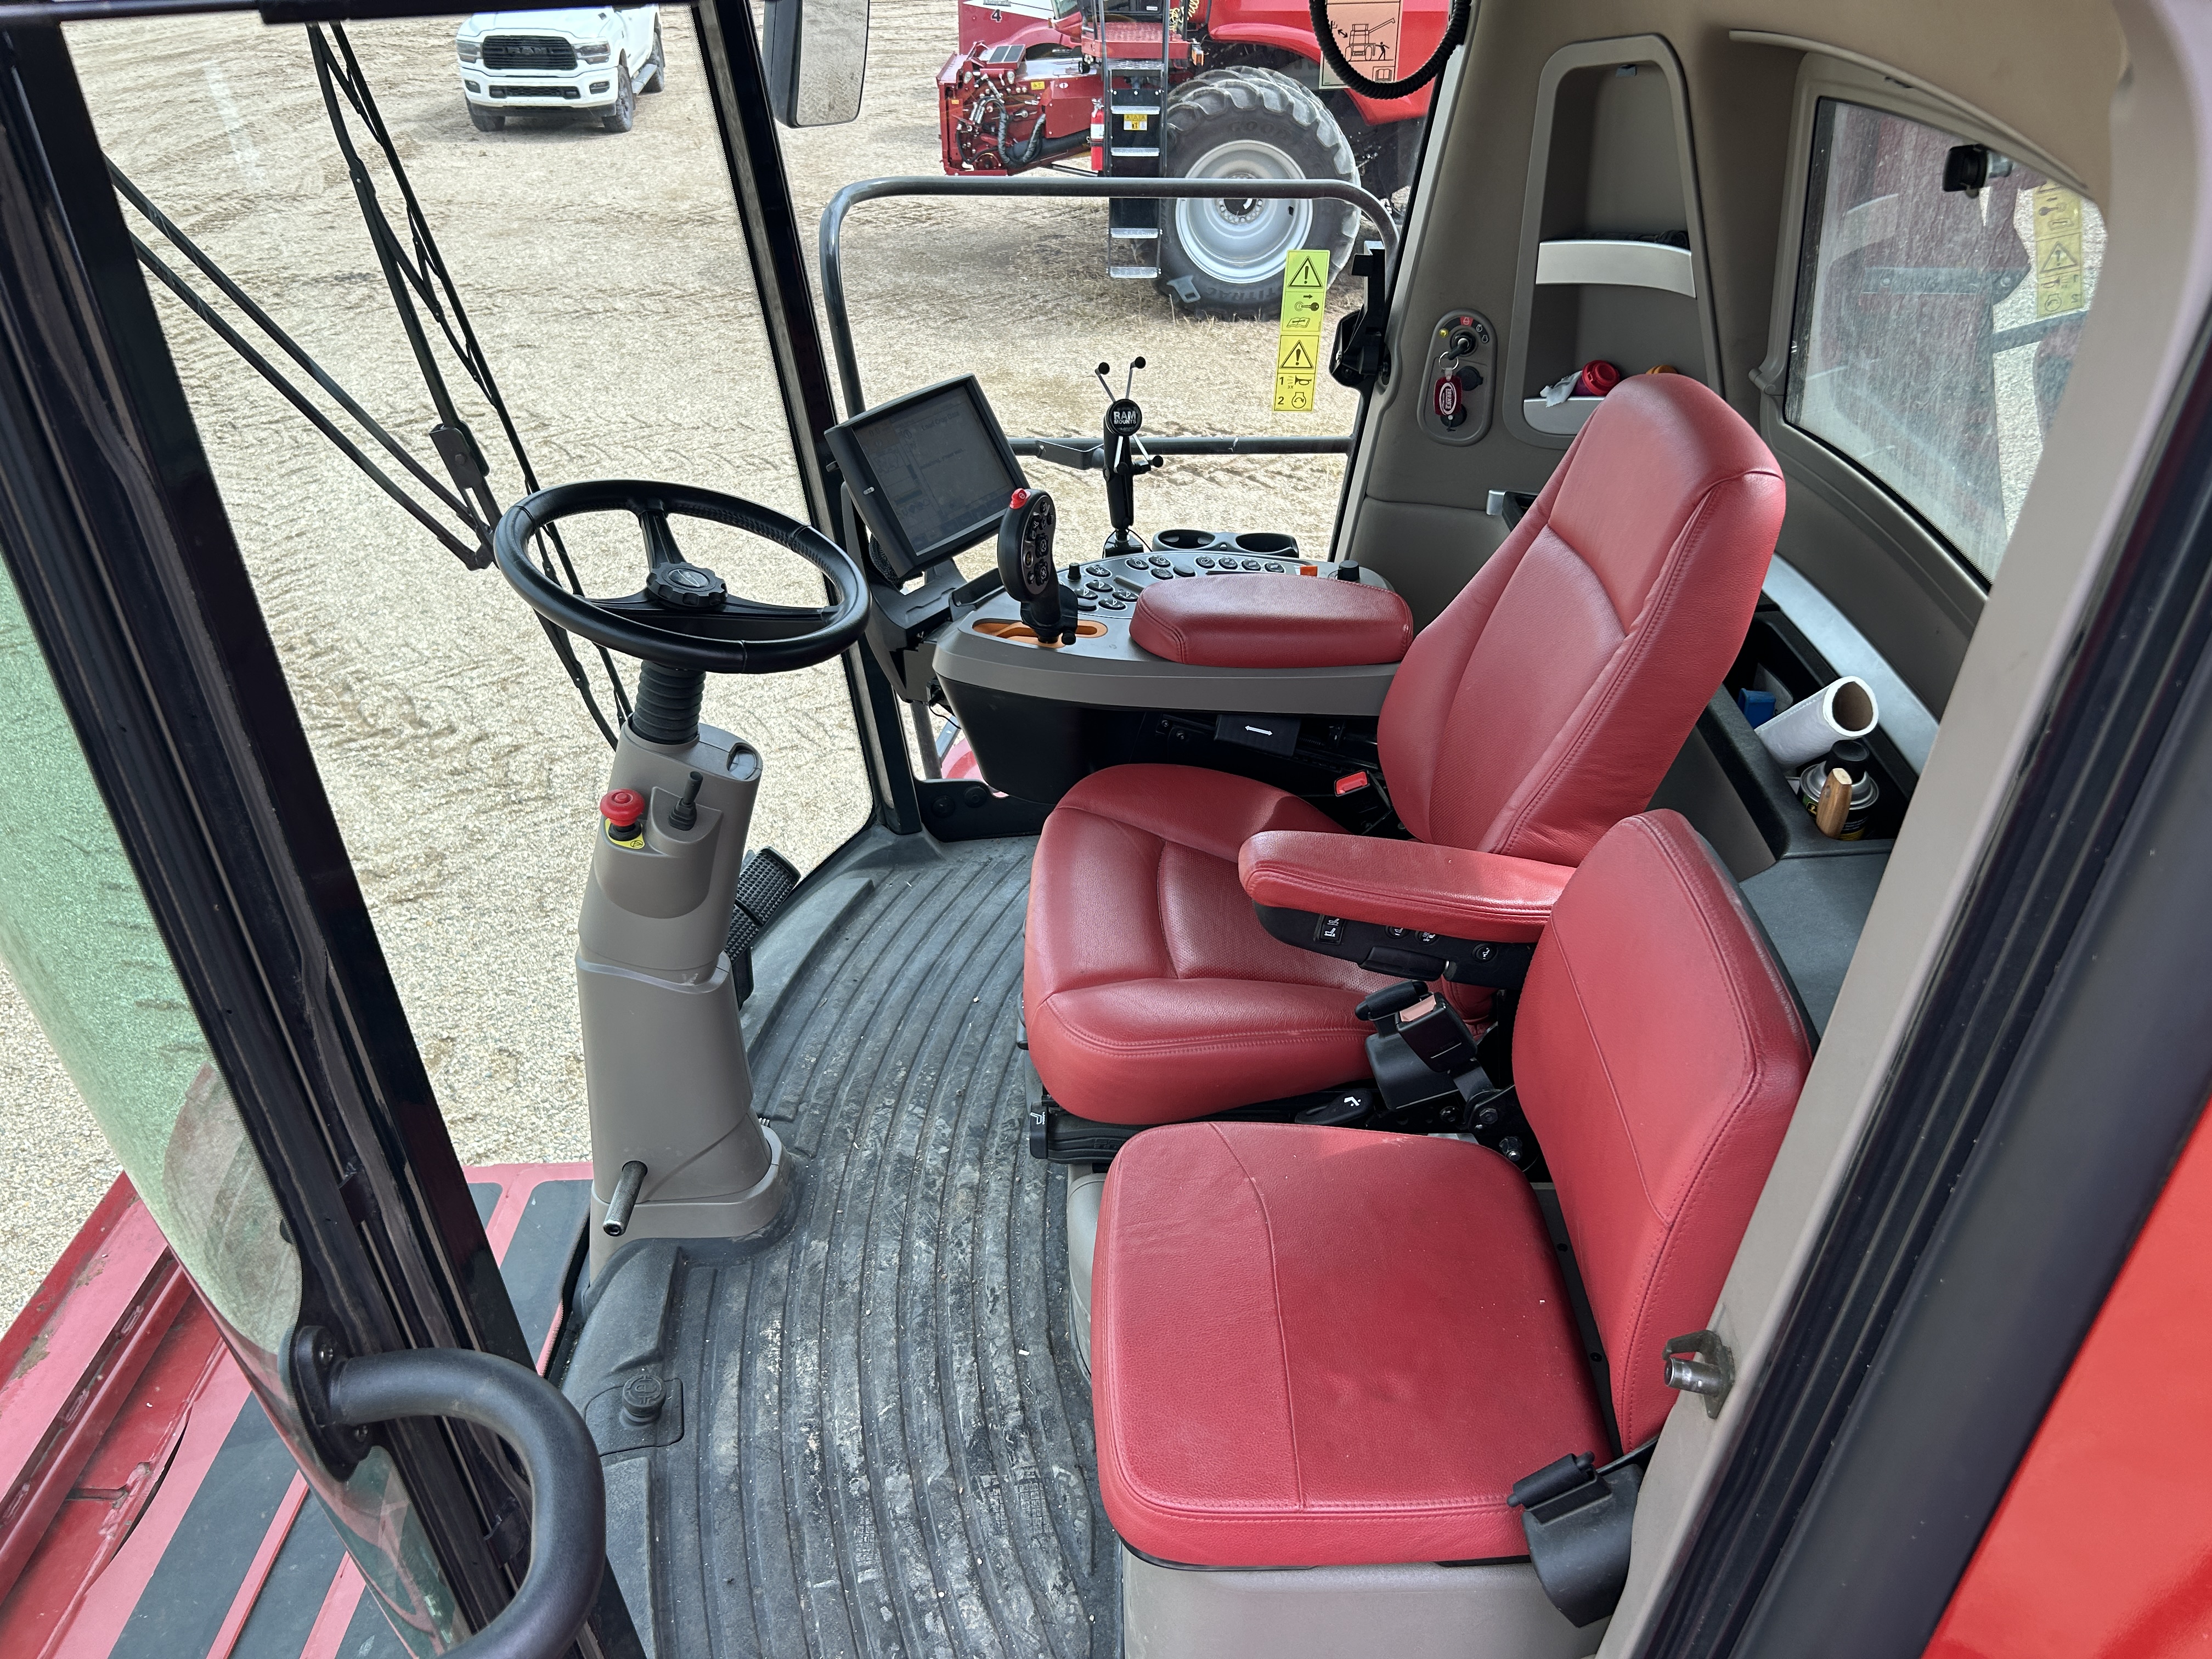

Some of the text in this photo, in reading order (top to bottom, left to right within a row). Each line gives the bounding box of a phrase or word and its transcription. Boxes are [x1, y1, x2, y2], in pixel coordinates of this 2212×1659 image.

[991, 9, 1002, 22] 4
[506, 46, 548, 55] RAM
[1279, 376, 1284, 385] 1
[1277, 396, 1284, 405] 2
[1113, 411, 1136, 420] RAM
